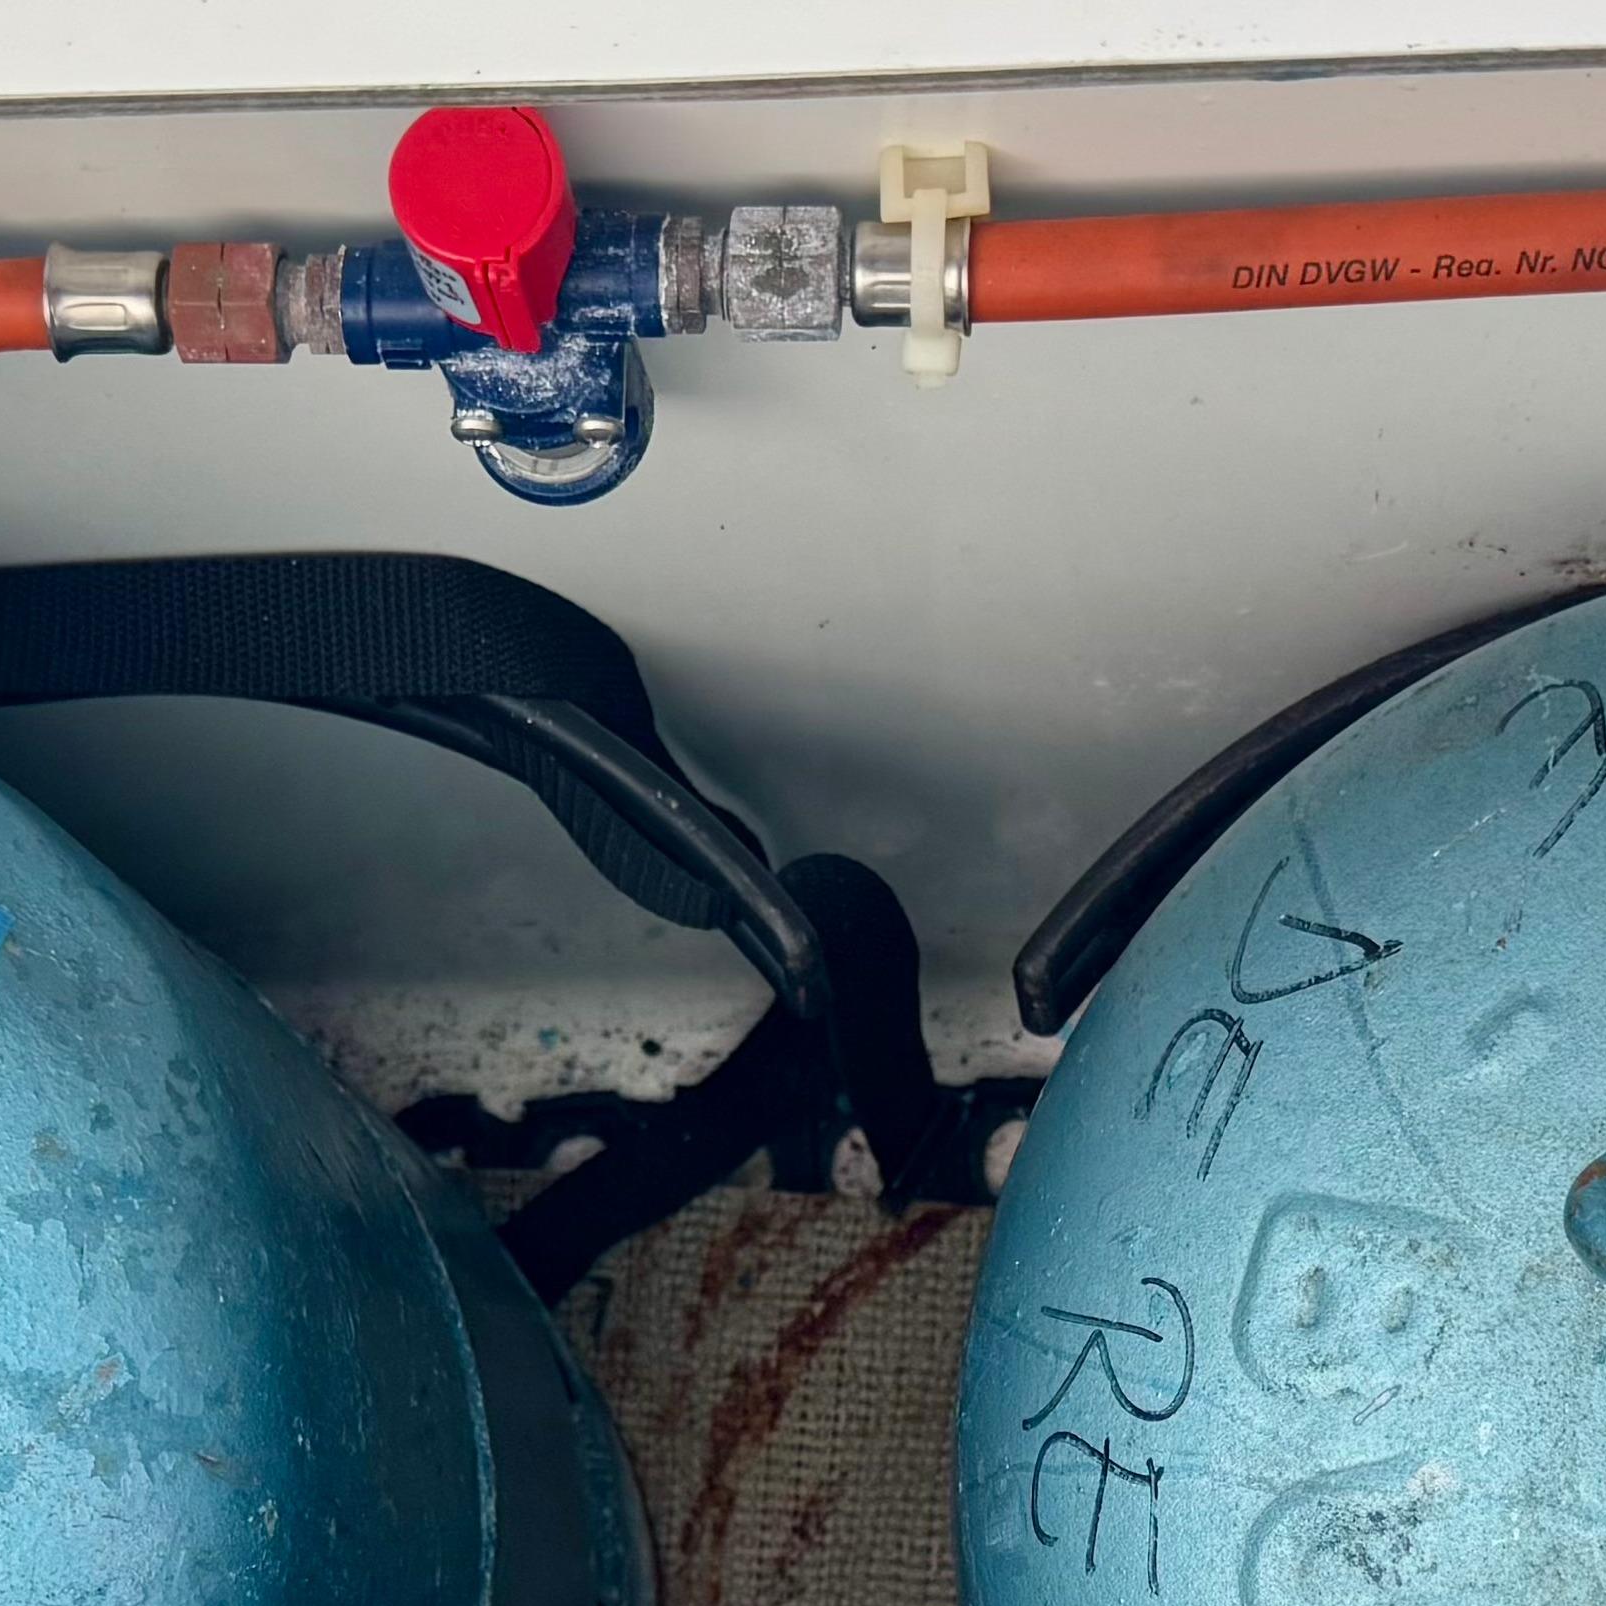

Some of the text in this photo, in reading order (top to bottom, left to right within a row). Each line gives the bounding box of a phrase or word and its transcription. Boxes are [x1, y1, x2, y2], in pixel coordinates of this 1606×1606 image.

[1231, 263, 1289, 290] DIN
[1299, 257, 1400, 288] DVGW
[1515, 248, 1558, 275] Nr.
